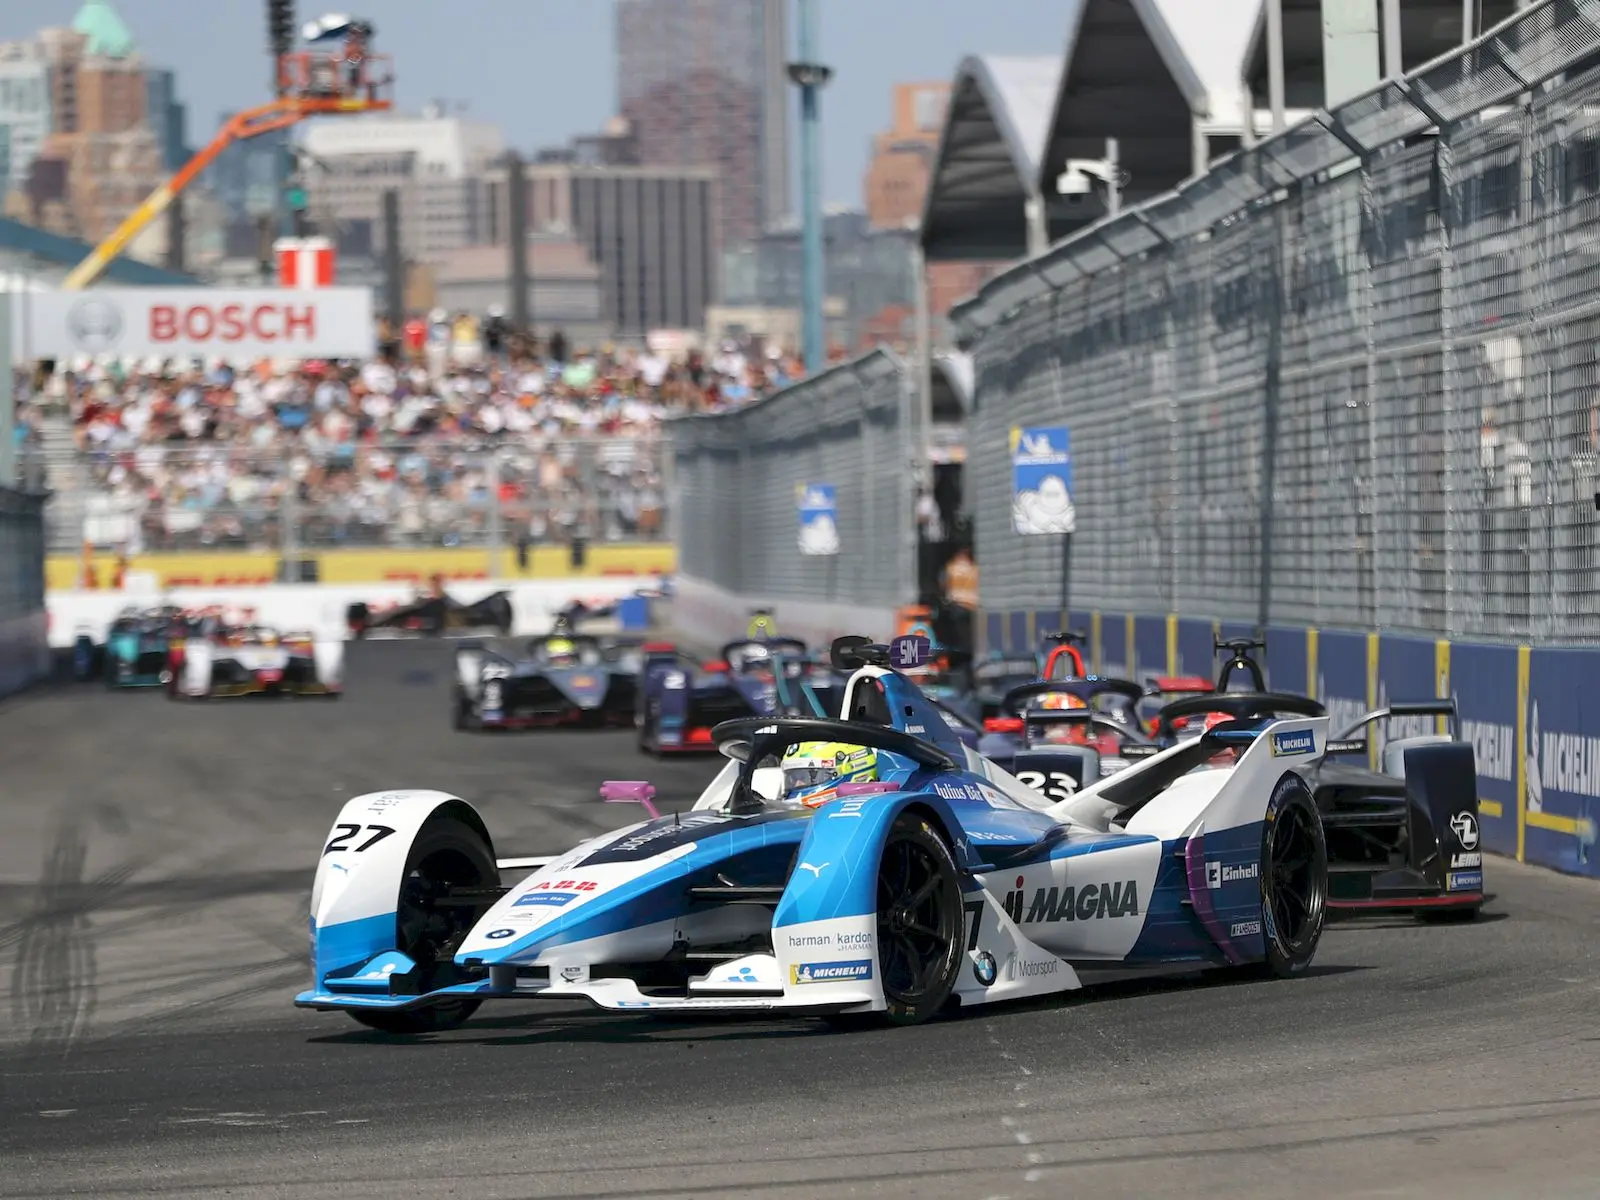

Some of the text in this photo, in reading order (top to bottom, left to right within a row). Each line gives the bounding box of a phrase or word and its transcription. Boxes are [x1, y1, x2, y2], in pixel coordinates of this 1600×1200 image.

[149, 303, 316, 341] BOSCH
[1282, 737, 1311, 749] MICHELIN
[1542, 731, 1600, 797] MICHELIN
[934, 783, 967, 800] Julius
[322, 823, 397, 858] 27
[1222, 863, 1258, 881] Einhell
[525, 880, 598, 891] ABB
[1025, 880, 1139, 923] MAGNA
[813, 966, 868, 978] MICHELIN
[1018, 959, 1058, 977] Motorsport
